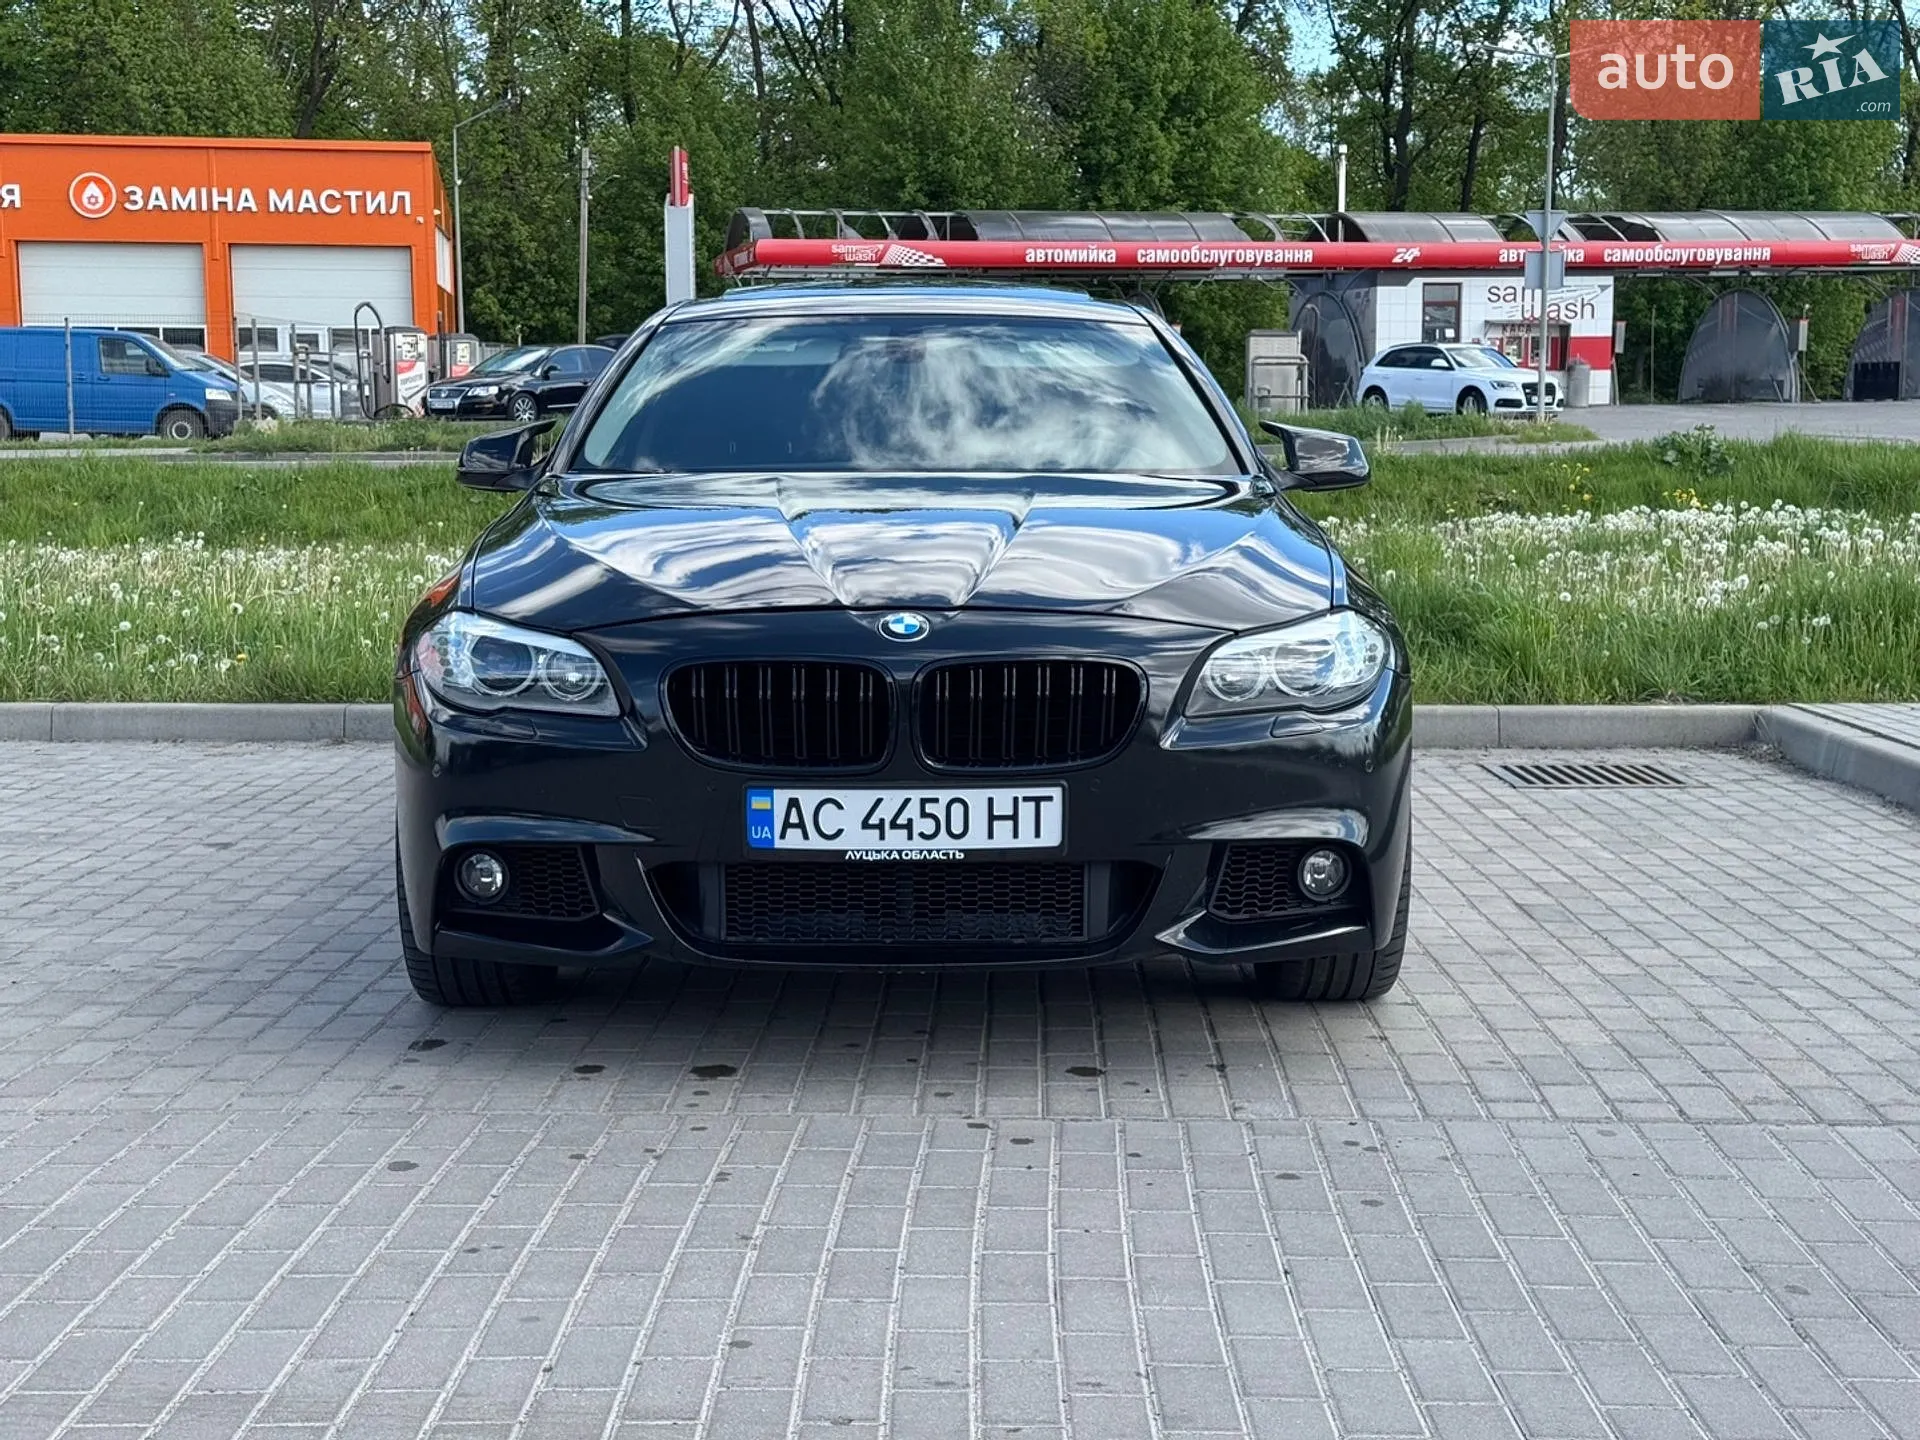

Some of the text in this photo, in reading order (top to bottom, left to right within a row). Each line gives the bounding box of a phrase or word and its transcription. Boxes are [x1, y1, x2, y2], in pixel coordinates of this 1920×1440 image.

[123, 185, 412, 215] ЗАМІНА МАСТИЛ
[1025, 245, 1313, 266] автомийка самообслуговування
[1498, 244, 1771, 264] автка самообслуговування
[779, 795, 1054, 841] AC 4450 HT
[751, 826, 772, 839] UA
[845, 850, 965, 861] ЛУЦЬКА ОБЛАСТЬ
